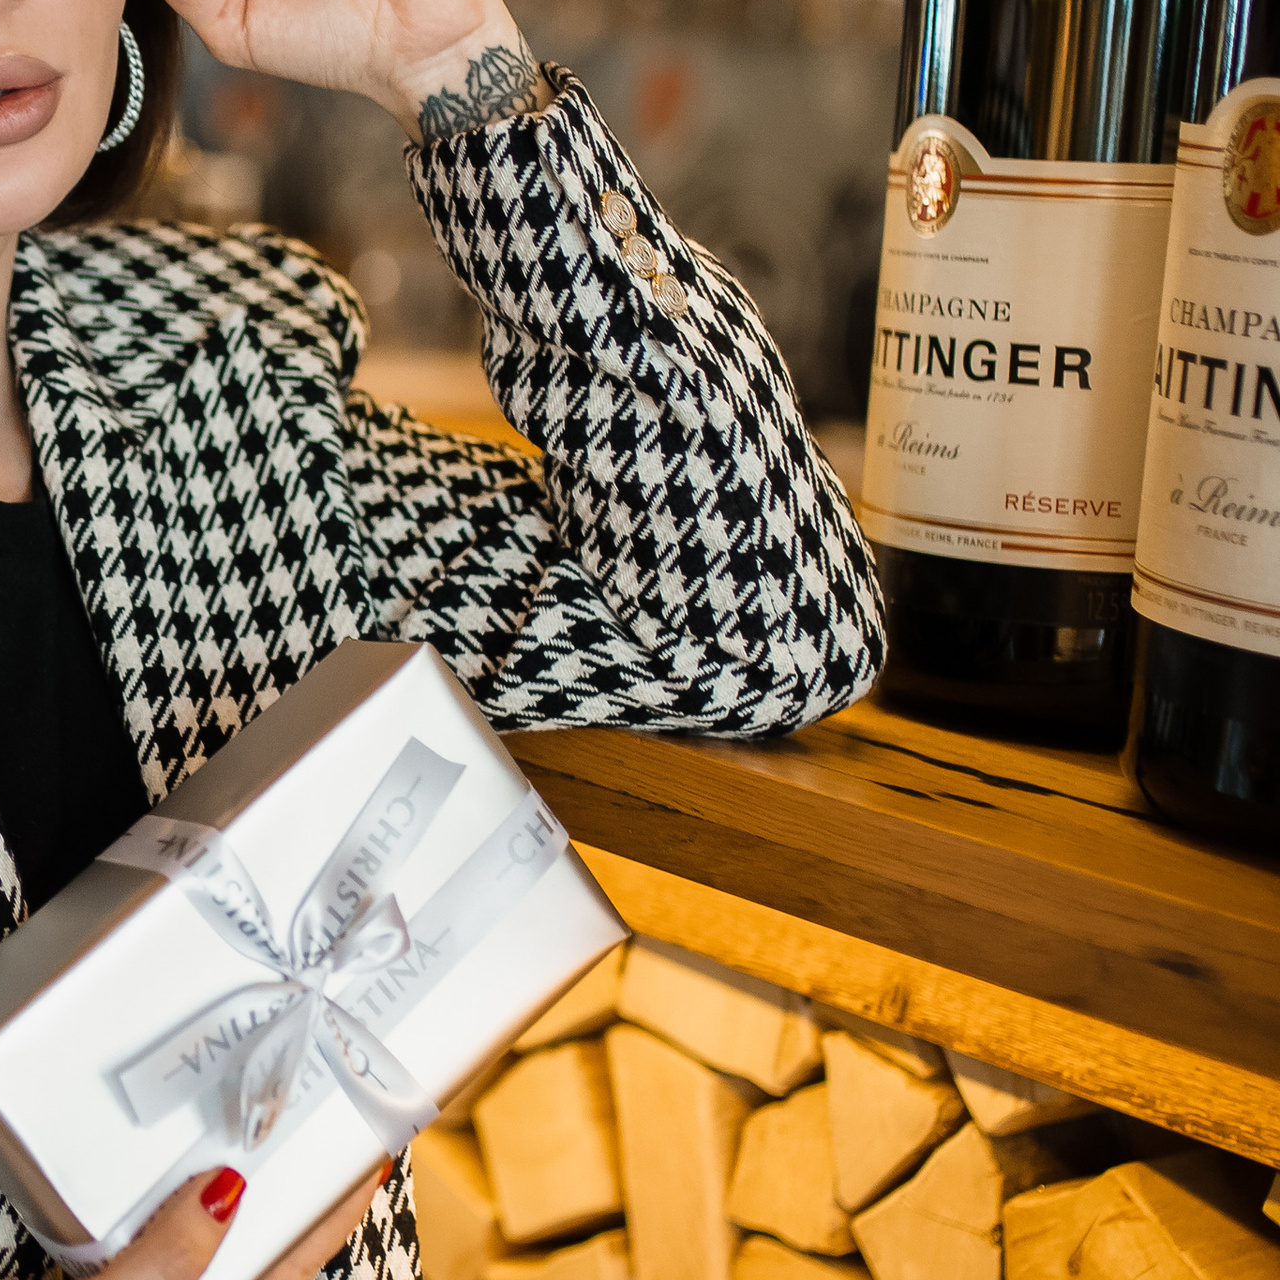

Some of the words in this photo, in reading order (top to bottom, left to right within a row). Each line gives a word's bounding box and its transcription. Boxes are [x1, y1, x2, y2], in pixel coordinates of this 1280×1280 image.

[887, 420, 961, 460] Reims
[1005, 491, 1122, 518] RÉSERVE
[957, 535, 999, 550] FRANCE
[1196, 524, 1249, 547] FRANCE
